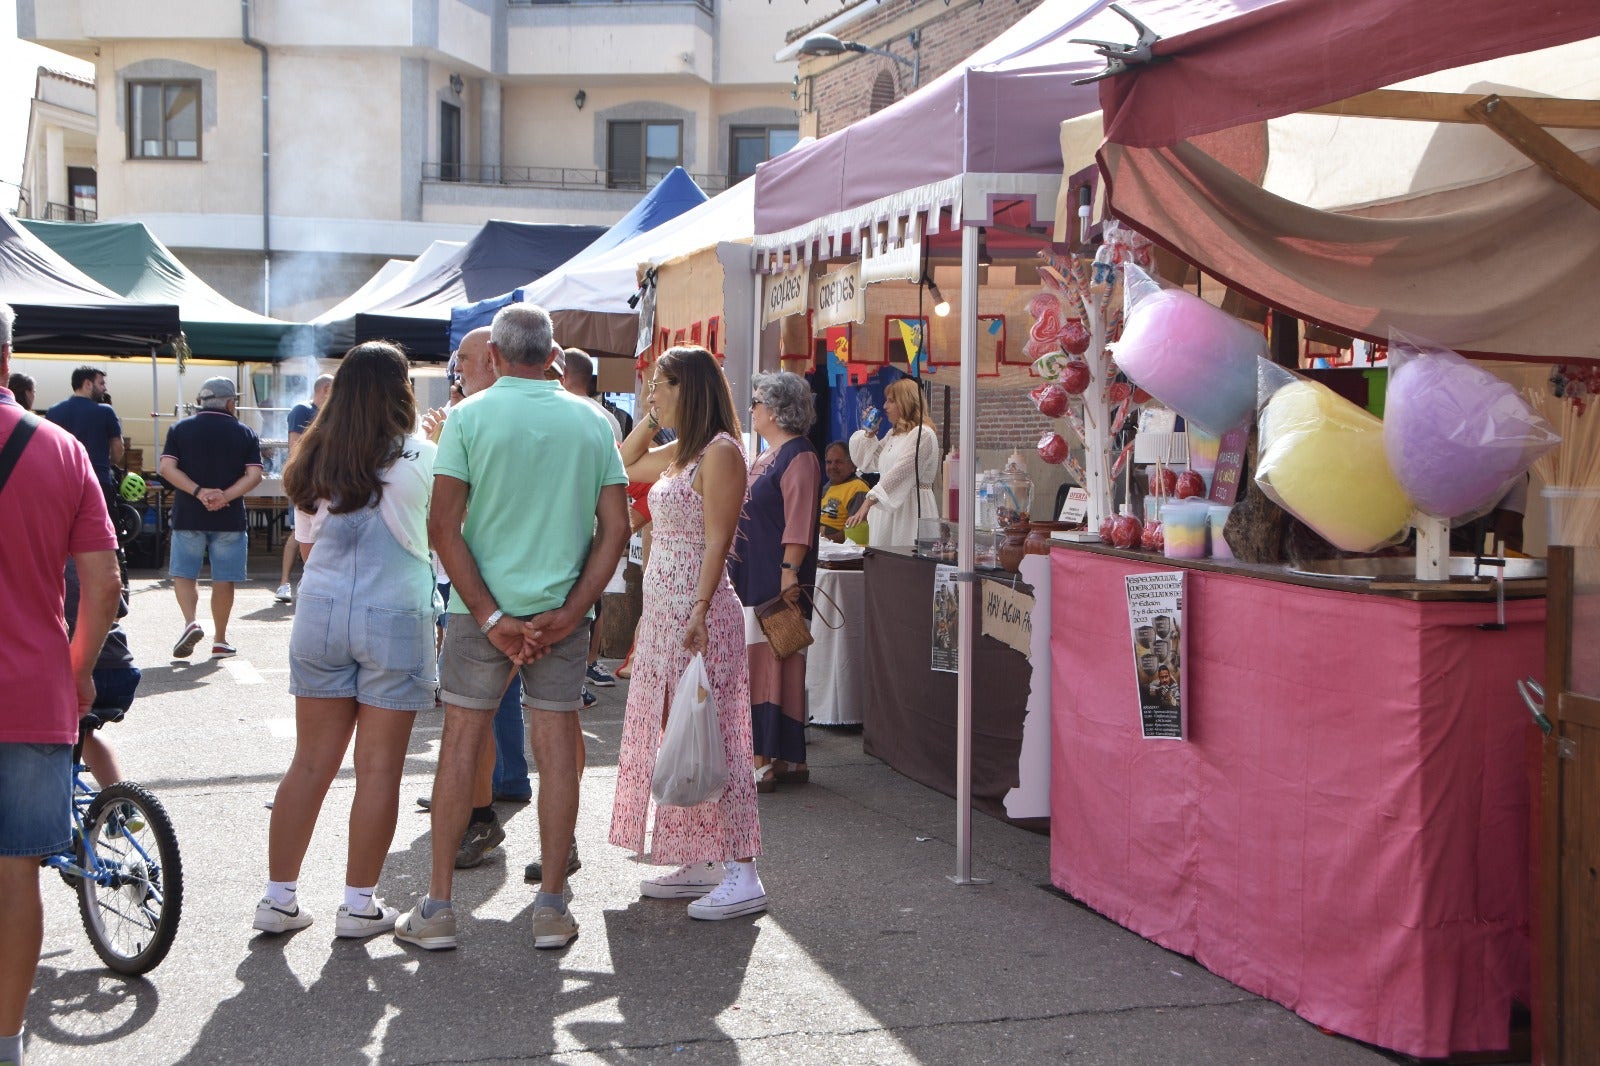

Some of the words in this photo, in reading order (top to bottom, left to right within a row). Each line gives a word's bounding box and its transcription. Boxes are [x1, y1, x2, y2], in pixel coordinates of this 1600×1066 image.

[771, 274, 801, 312] GOFRES
[820, 274, 855, 313] CREPES
[1129, 575, 1178, 584] ESPECTACULAR
[1130, 583, 1164, 591] MERCADO
[1131, 591, 1173, 599] CASTELLANOS
[987, 591, 1002, 618] HAY
[1002, 601, 1021, 626] AGUA
